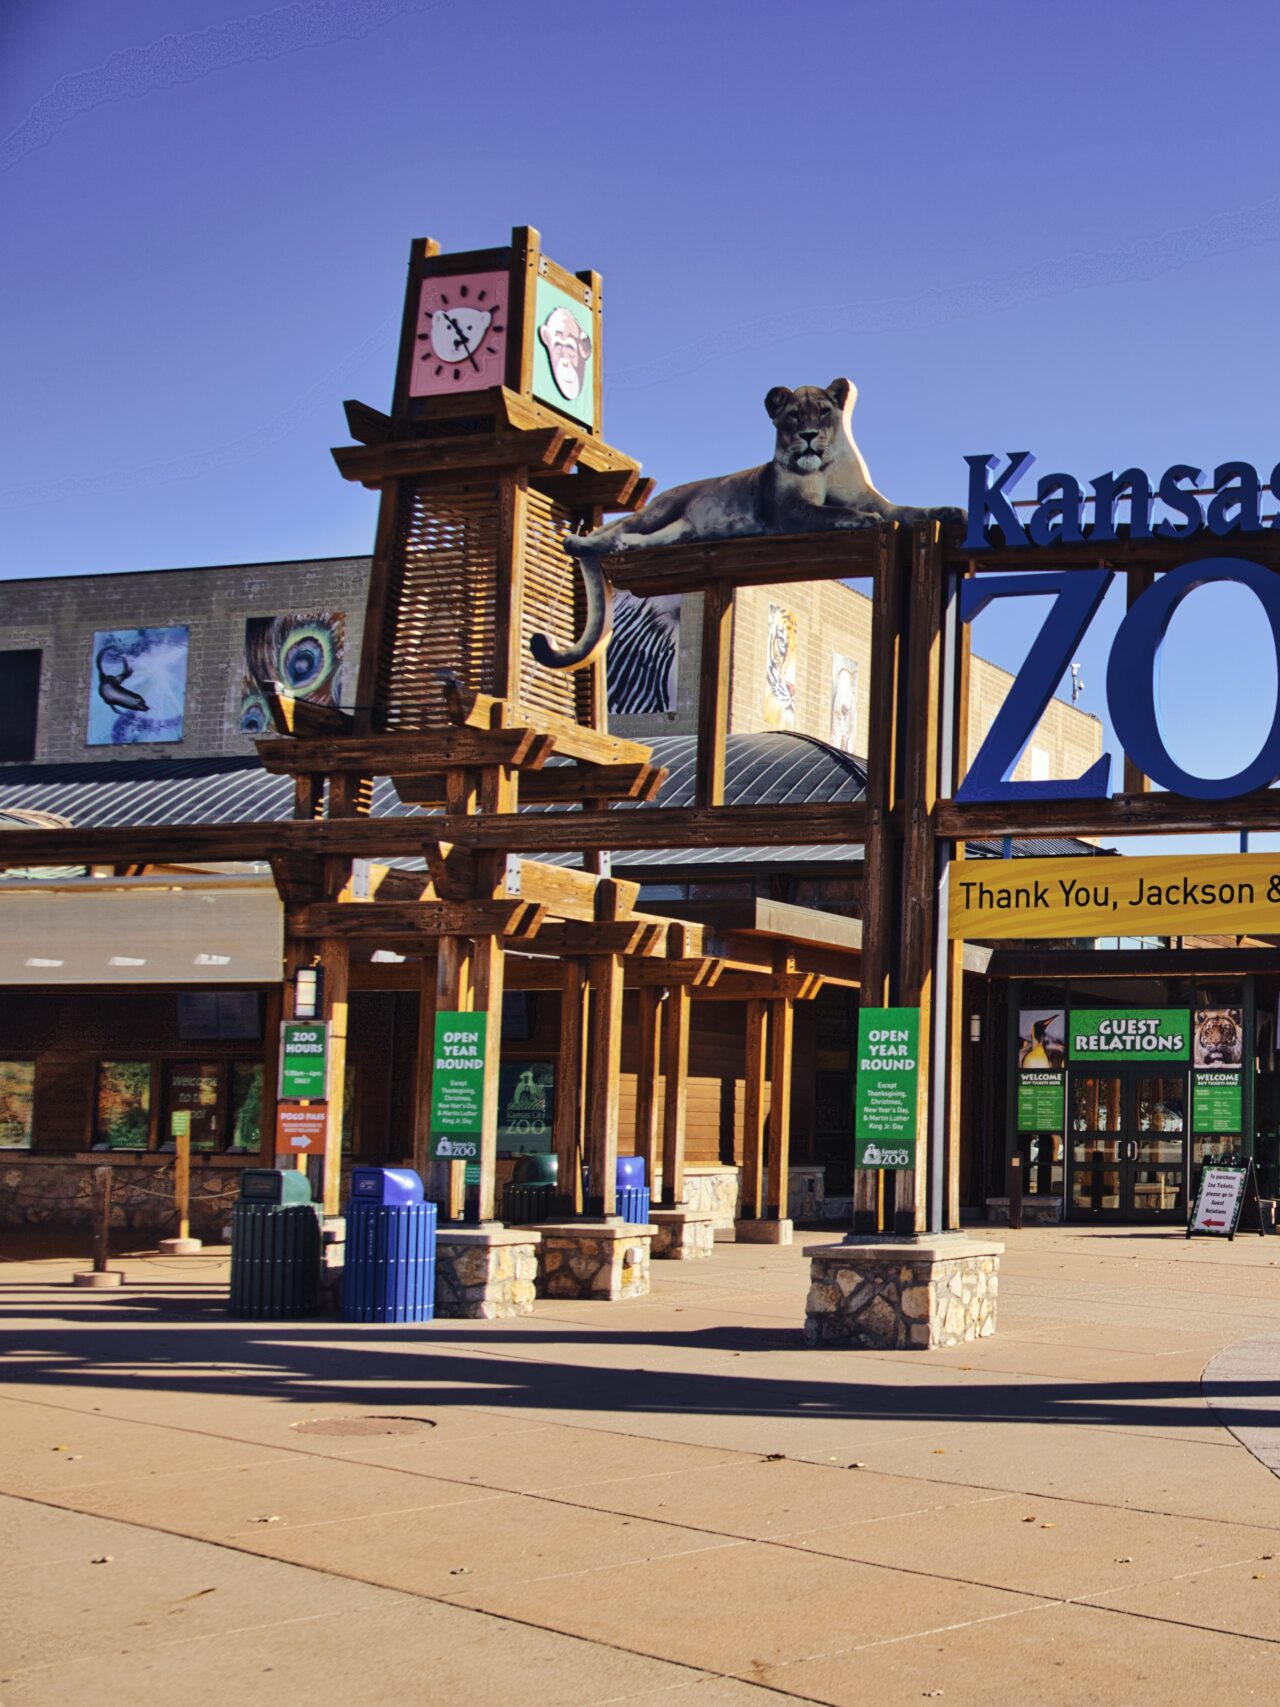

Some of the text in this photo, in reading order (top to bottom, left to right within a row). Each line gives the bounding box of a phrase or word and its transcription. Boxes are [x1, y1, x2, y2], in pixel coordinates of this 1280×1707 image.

[959, 880, 1050, 909] Thank
[1058, 879, 1118, 911] You,
[1129, 877, 1254, 906] Jackson
[1099, 1019, 1159, 1035] GUEST
[292, 1032, 317, 1042] ZOO
[443, 1032, 478, 1043] OPEN
[868, 1030, 909, 1041] OPEN
[285, 1044, 323, 1053] HOURS
[1075, 1035, 1183, 1051] RELATIONS
[443, 1045, 477, 1056] YEAR
[869, 1045, 908, 1056] YEAR
[436, 1058, 484, 1069] ROUND
[861, 1059, 916, 1071] ROUND
[1021, 1073, 1062, 1081] WELCOME
[179, 1092, 191, 1103] to
[506, 1119, 546, 1135] ZOO
[892, 1123, 904, 1131] Day
[452, 1146, 476, 1156] ZOO
[881, 1154, 909, 1165] ZOO
